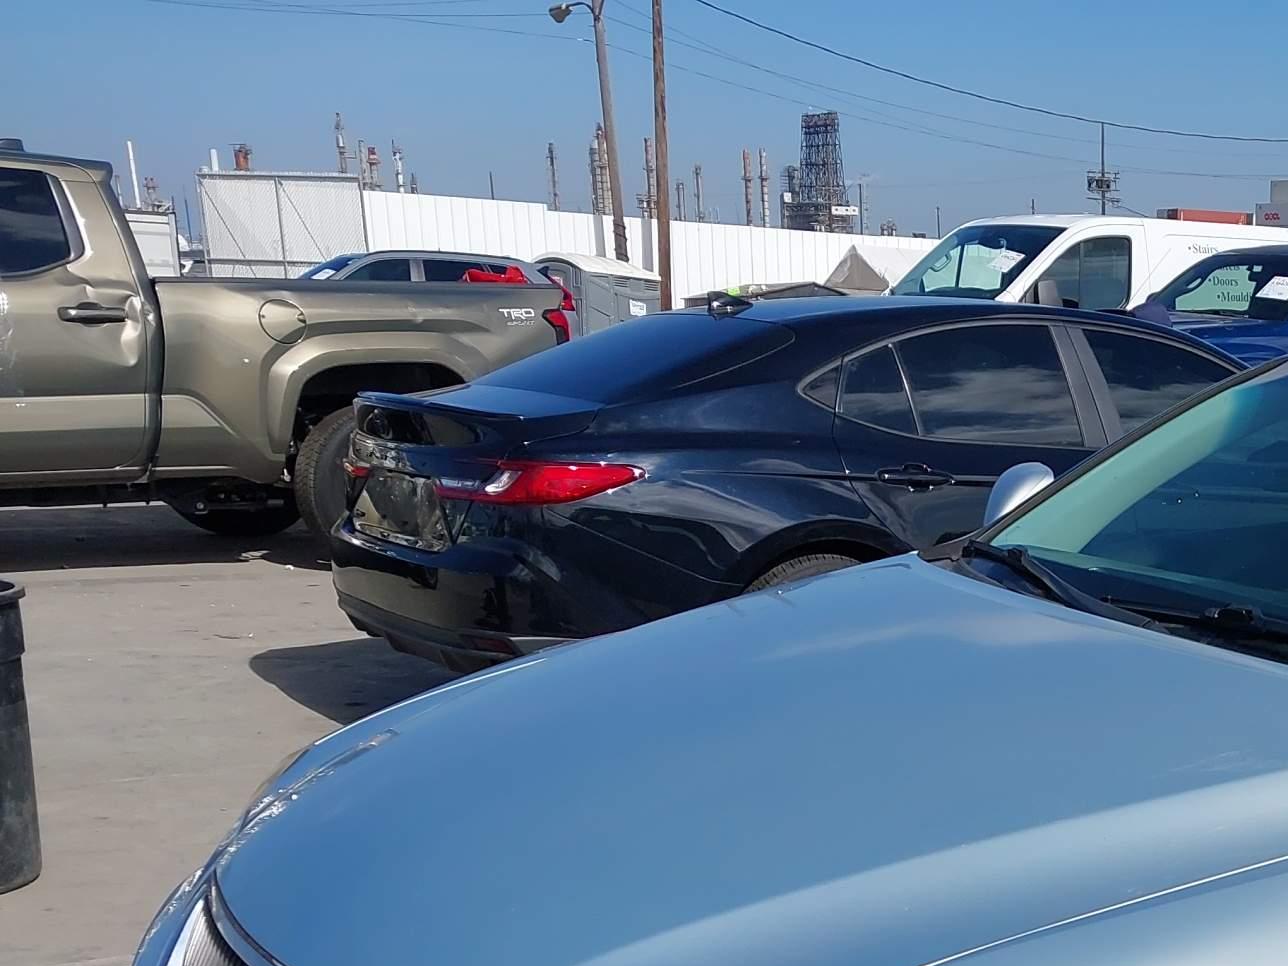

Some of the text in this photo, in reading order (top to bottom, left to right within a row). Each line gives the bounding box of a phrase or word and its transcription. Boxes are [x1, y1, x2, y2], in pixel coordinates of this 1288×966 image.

[1192, 244, 1219, 254] Stairs
[1212, 276, 1239, 287] Doors
[498, 308, 535, 320] TRD
